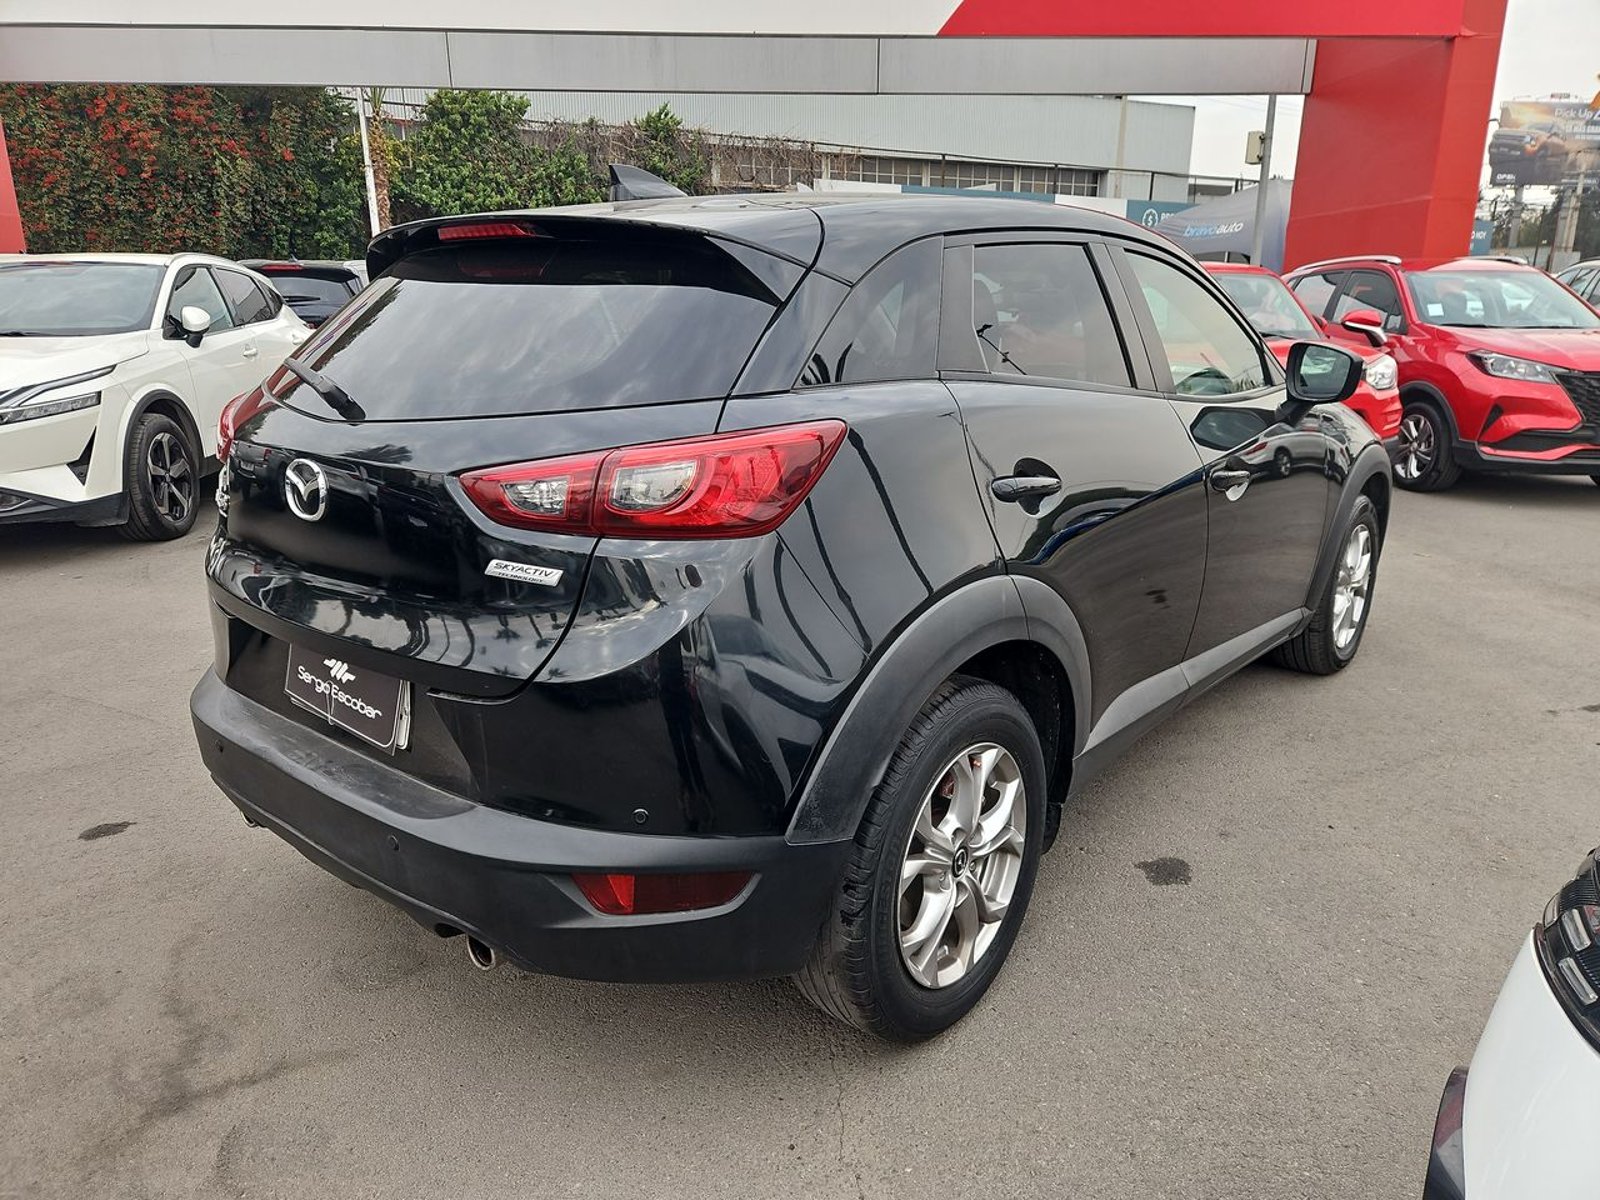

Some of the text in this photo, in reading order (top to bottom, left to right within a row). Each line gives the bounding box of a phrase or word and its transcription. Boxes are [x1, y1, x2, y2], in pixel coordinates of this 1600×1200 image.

[1554, 108, 1577, 118] Pick
[1578, 109, 1594, 121] Up
[494, 562, 553, 577] SKYACTIV
[331, 684, 382, 719] Escobar
